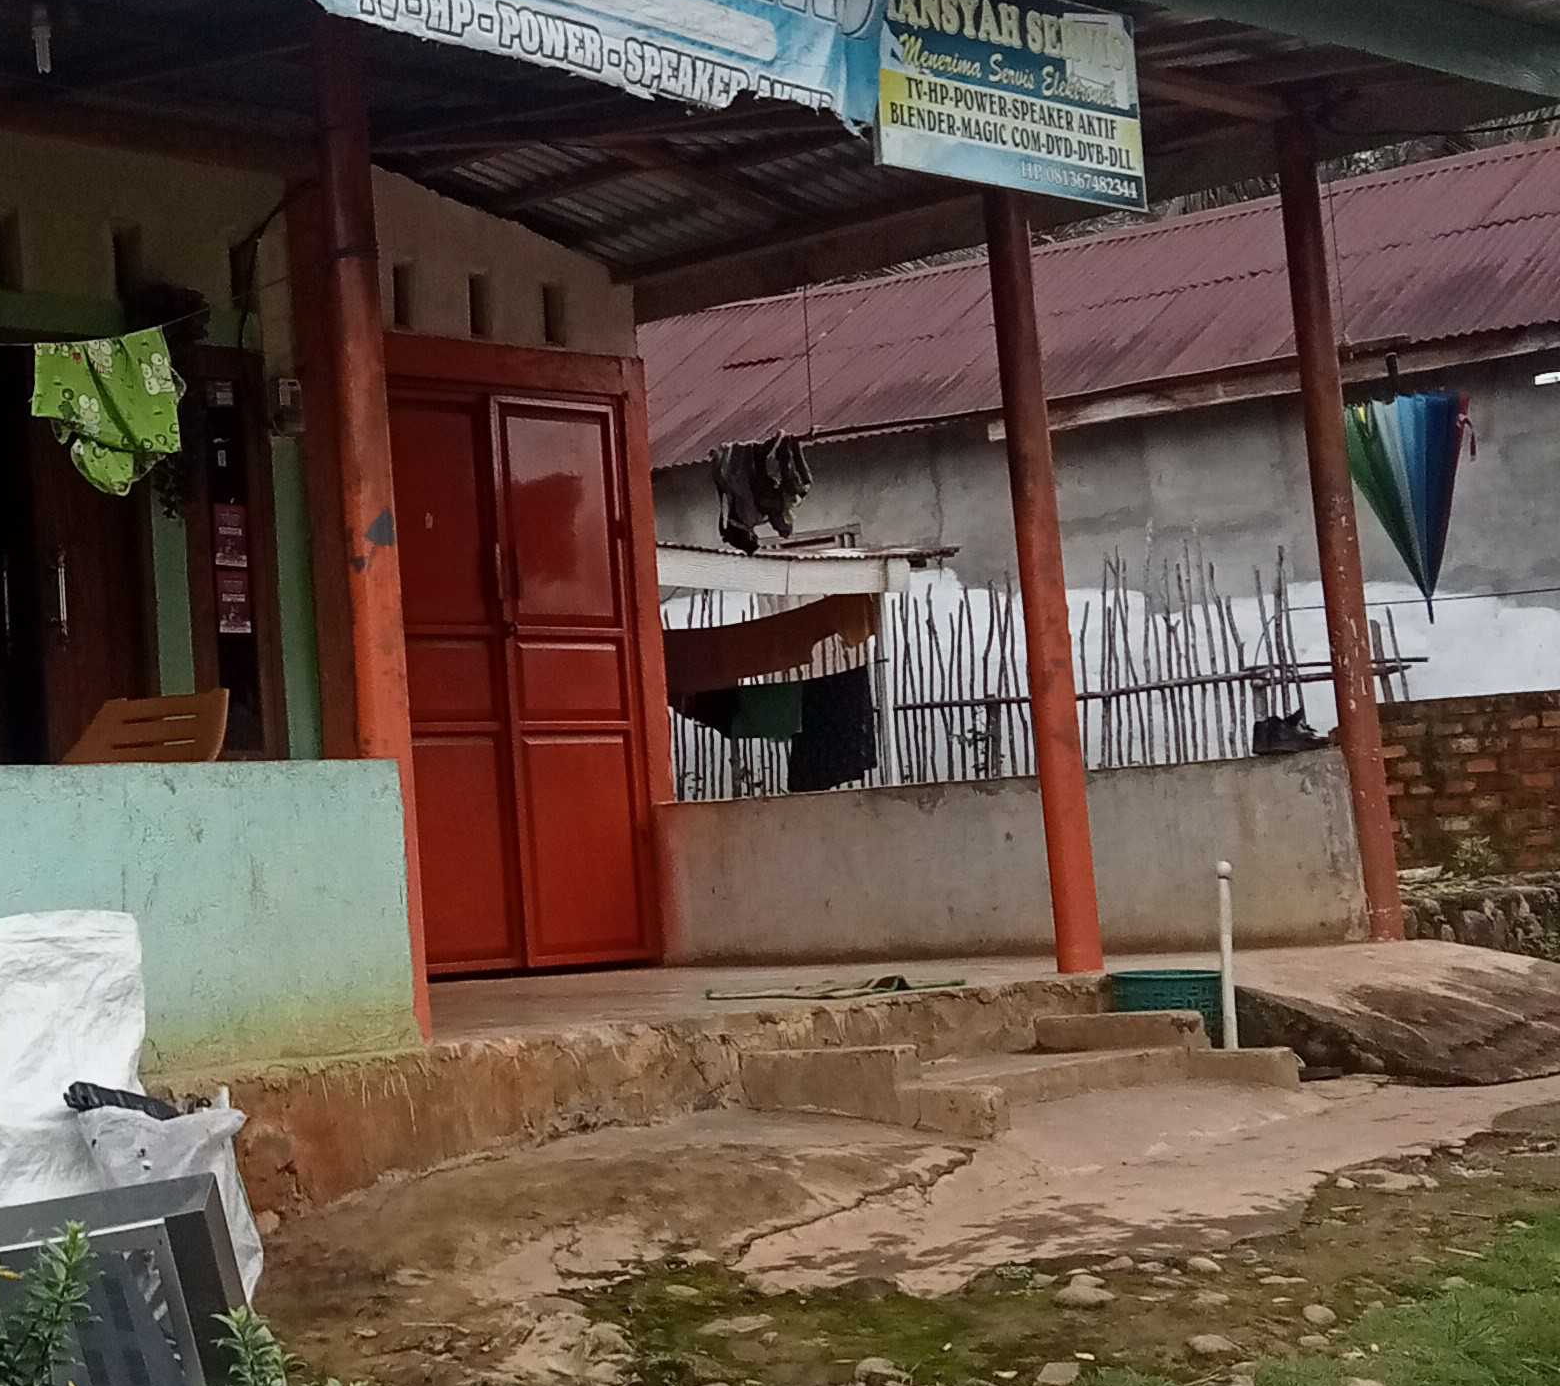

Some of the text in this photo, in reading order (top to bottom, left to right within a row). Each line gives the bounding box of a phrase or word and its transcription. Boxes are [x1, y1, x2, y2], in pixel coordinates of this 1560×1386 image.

[495, 0, 603, 73] POWER
[900, 33, 982, 78] Menerima
[988, 53, 1035, 91] Servis
[889, 101, 1136, 171] BLENDER-MAGIC COM-DVD-DVB-DLL
[905, 76, 1117, 140] TV-HP-POWER-SPEAKER AKTIF
